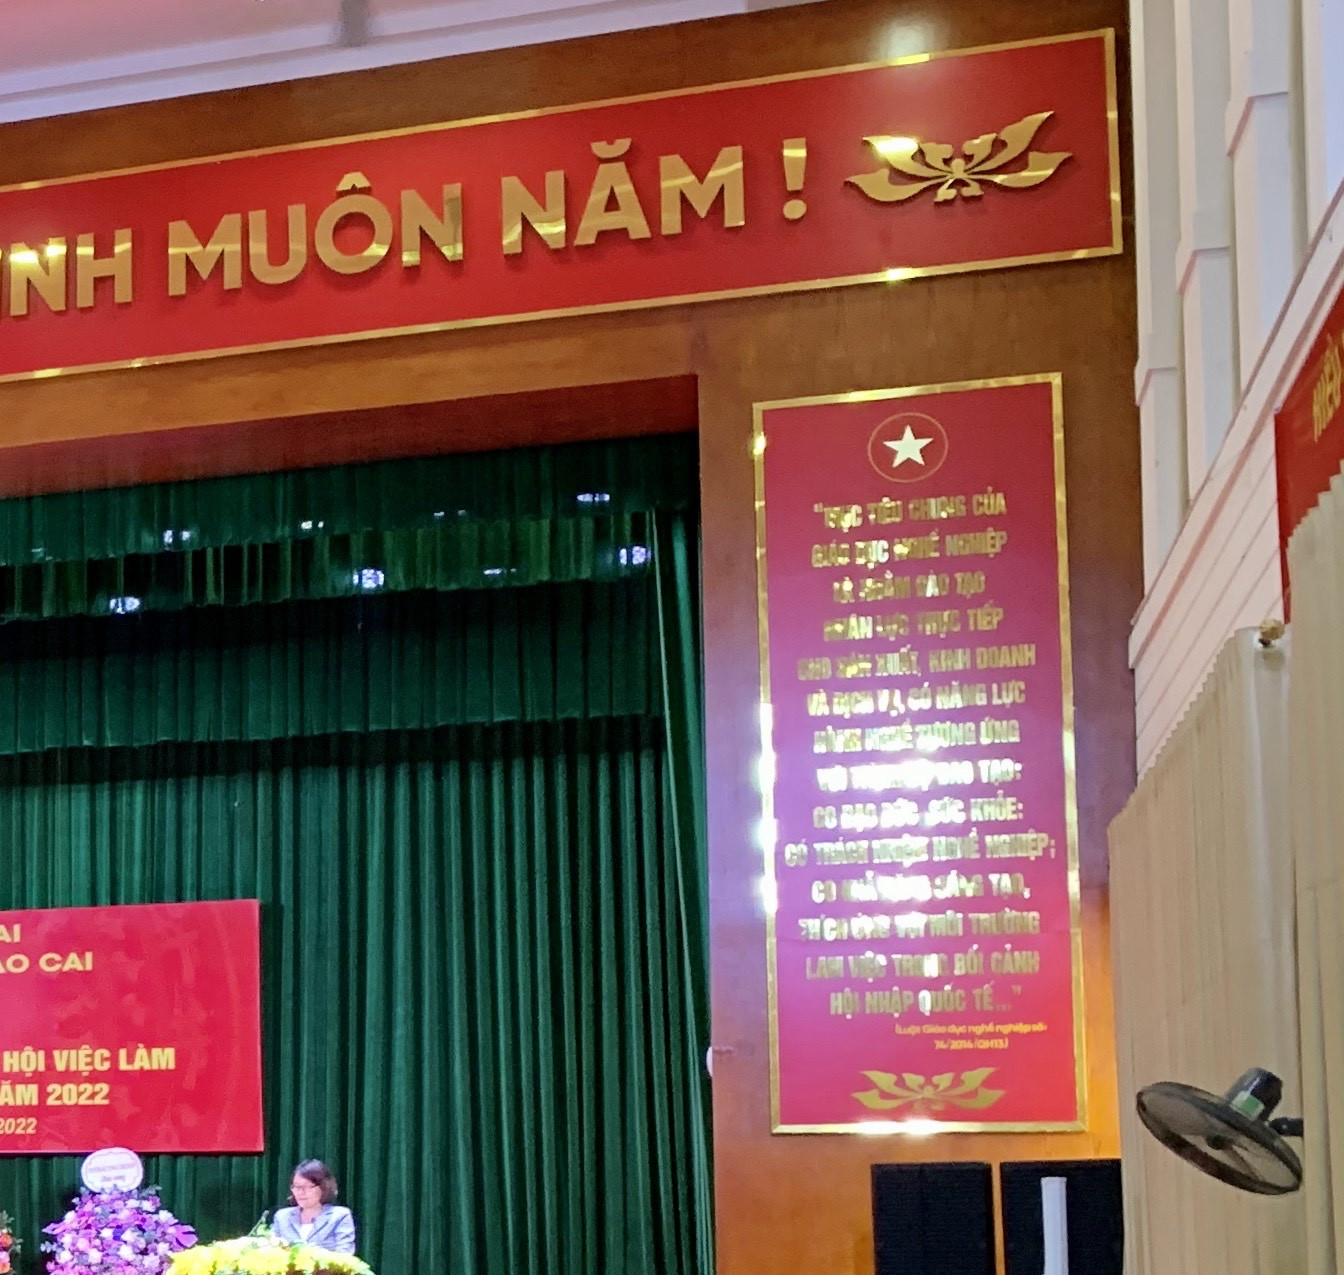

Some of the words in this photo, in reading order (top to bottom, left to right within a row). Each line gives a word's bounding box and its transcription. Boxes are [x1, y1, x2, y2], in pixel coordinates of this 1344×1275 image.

[167, 172, 465, 297] MUÔN
[500, 137, 745, 256] NĂM
[782, 137, 808, 221] !
[39, 951, 94, 972] CAI
[864, 985, 914, 1018] NHẬP
[918, 982, 967, 1016] QUỐC
[2, 1046, 45, 1078] HỘI
[53, 1045, 111, 1077] VIỆC
[118, 1043, 175, 1070] LÀM
[46, 1083, 110, 1106] 2022
